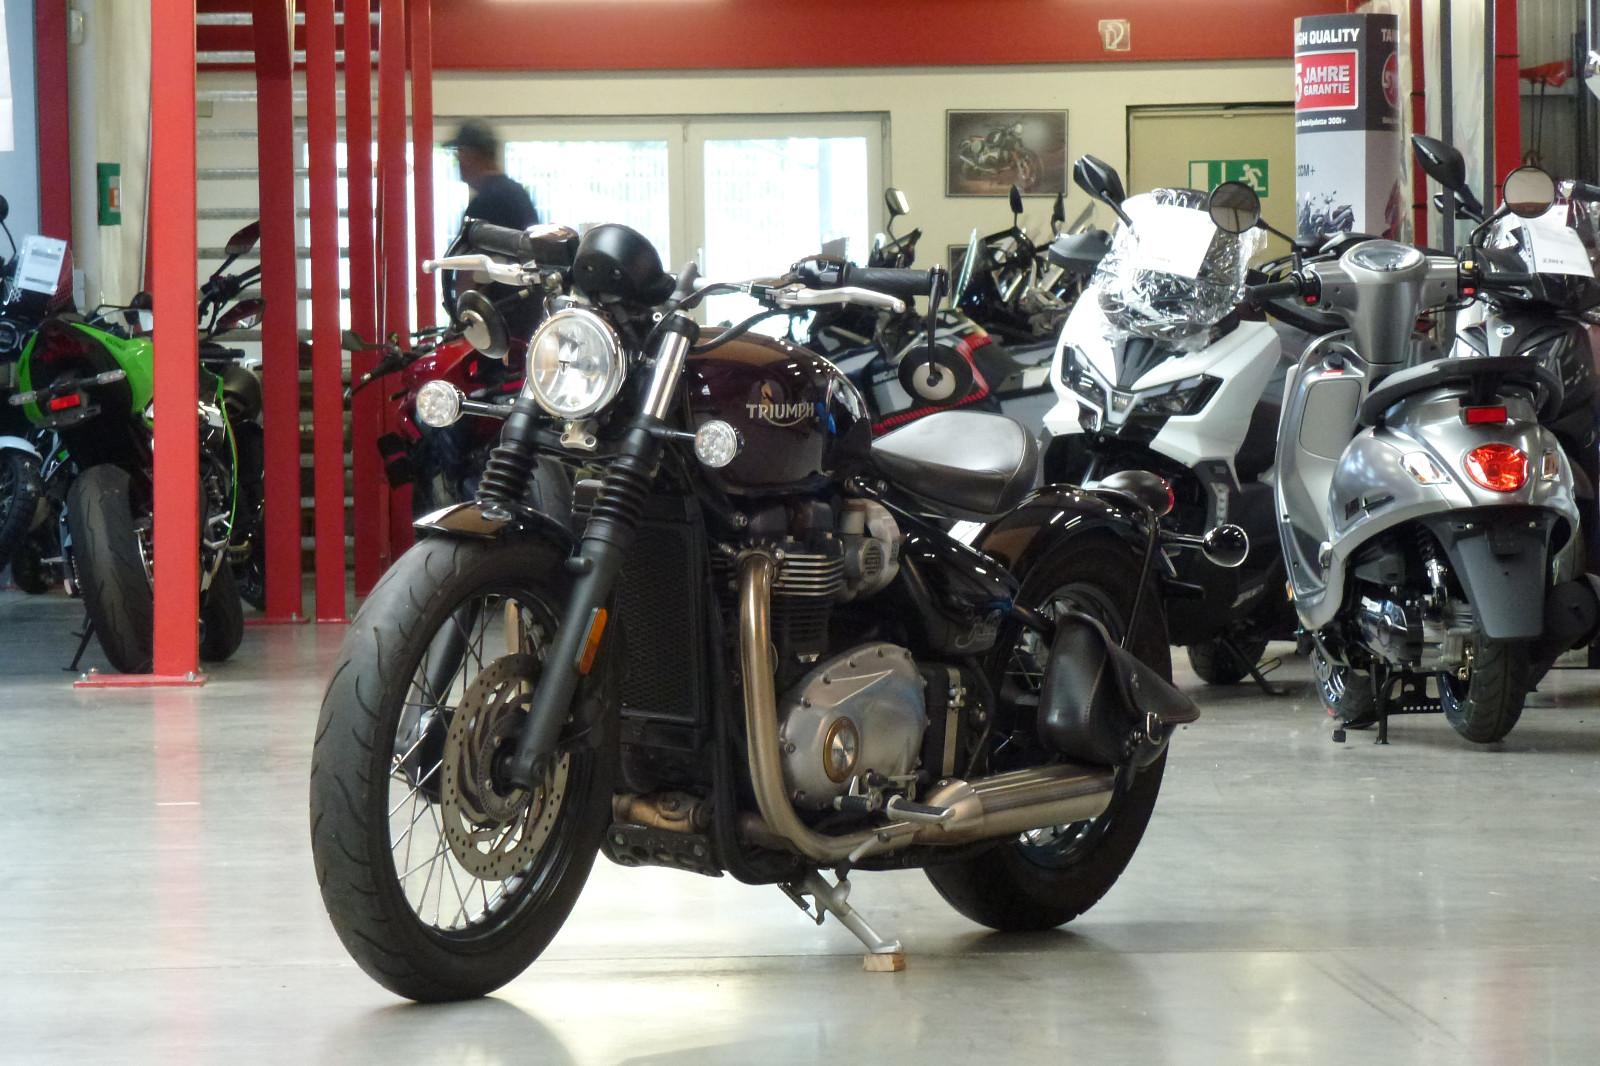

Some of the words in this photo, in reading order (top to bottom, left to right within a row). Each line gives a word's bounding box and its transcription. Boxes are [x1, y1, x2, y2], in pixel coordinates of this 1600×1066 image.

[1310, 28, 1360, 44] QUALITY
[1304, 65, 1350, 84] JAHRE
[1304, 83, 1350, 97] GARANTIE
[745, 402, 814, 426] TRIUMPH
